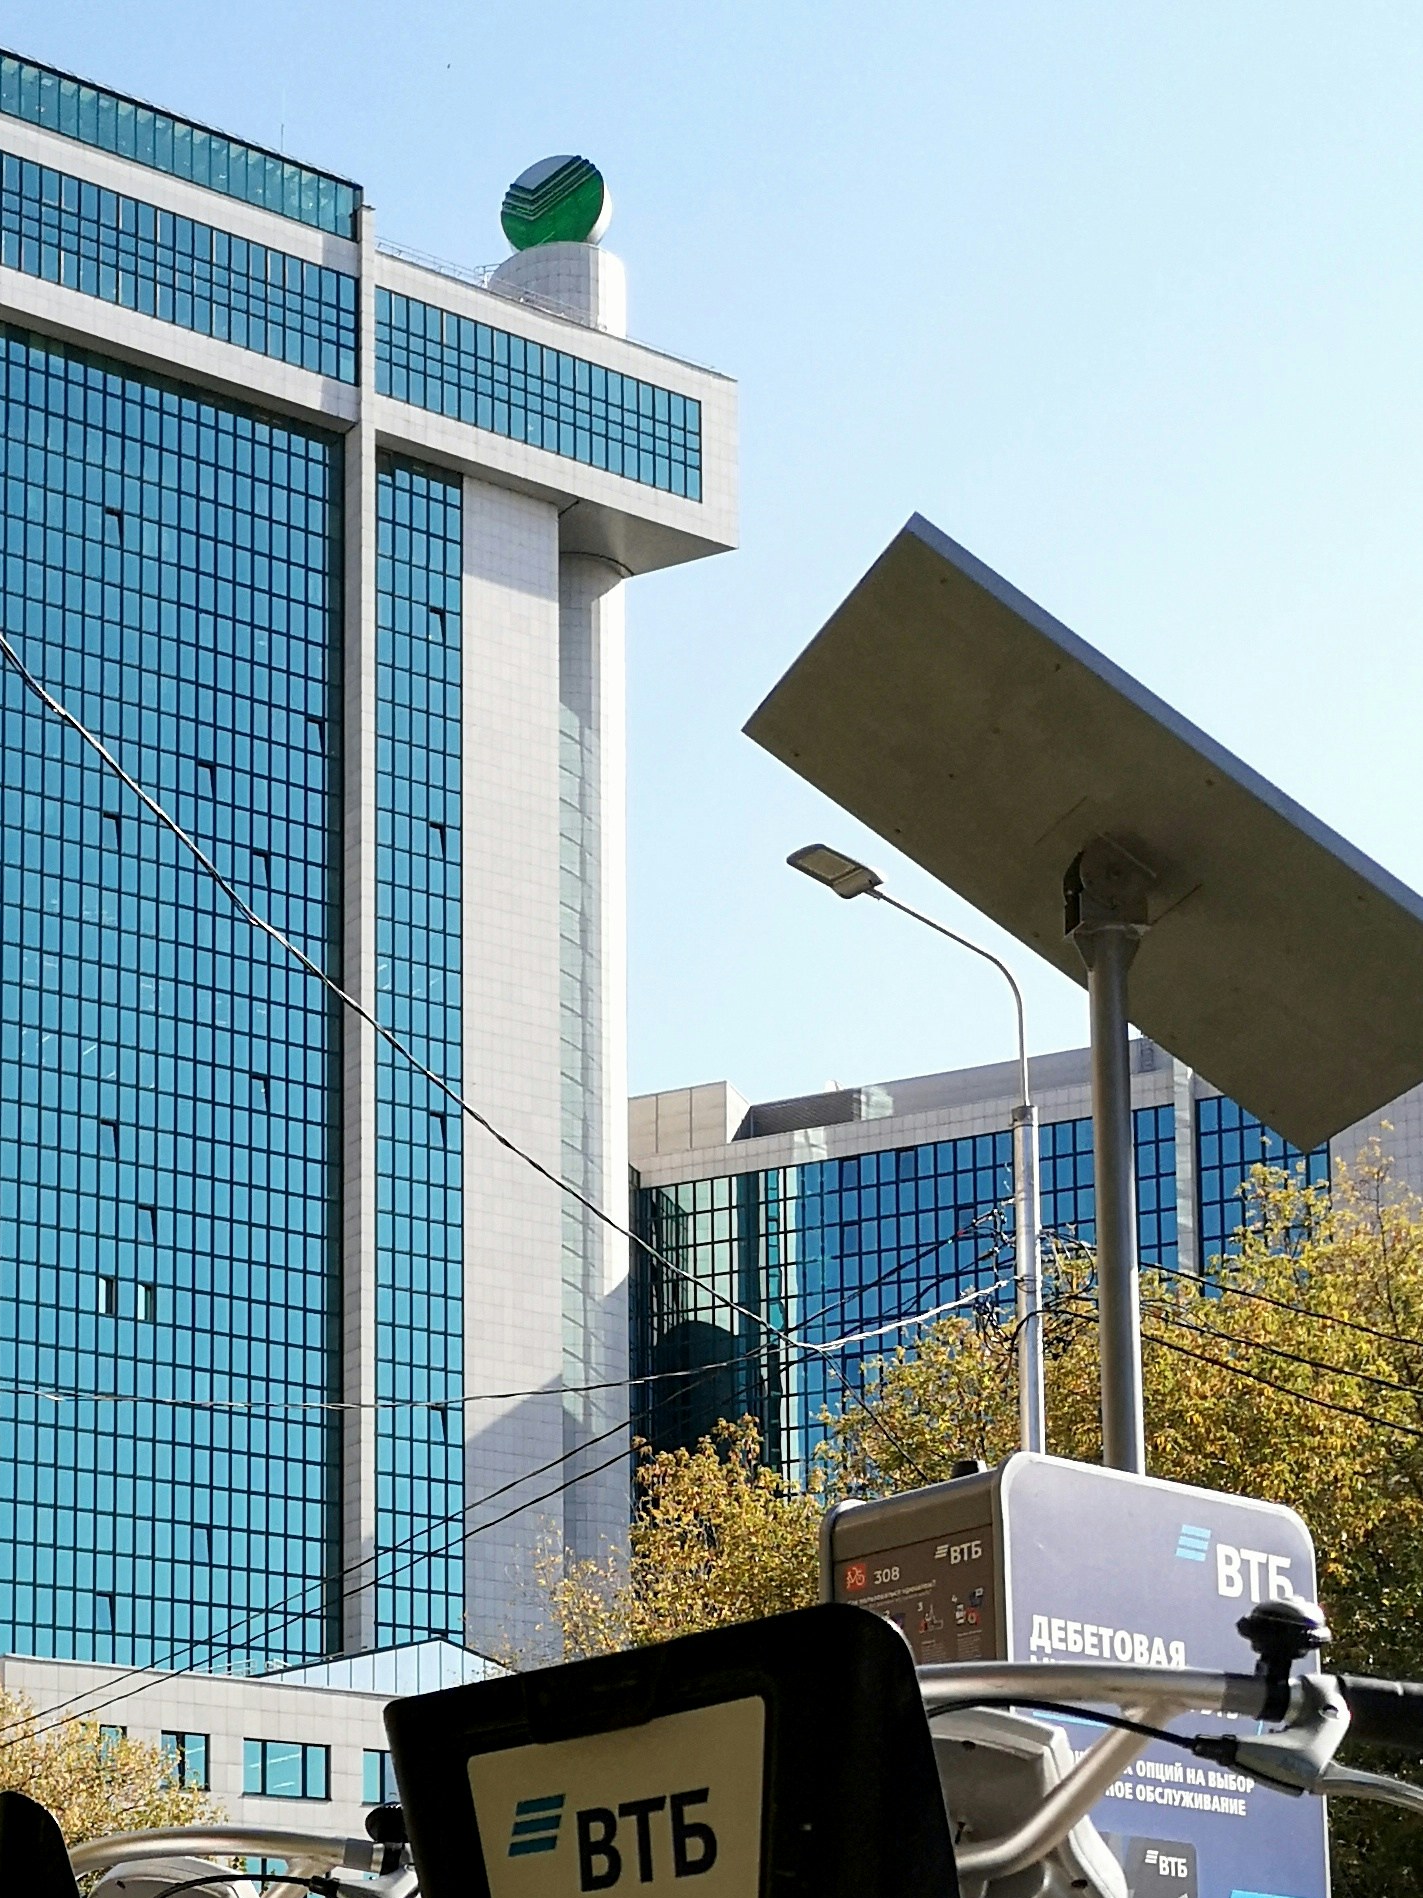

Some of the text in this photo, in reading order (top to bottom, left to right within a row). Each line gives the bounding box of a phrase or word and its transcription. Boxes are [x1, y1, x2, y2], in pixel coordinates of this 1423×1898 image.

[950, 1540, 982, 1565] ВТБ
[873, 1566, 900, 1585] 308
[1216, 1543, 1294, 1603] ВТБ
[917, 1602, 924, 1612] 3
[1029, 1614, 1186, 1670] ДЕБЕТОВАЯ
[1135, 1760, 1255, 1794] ОПЦИЙ НА ВЫБОР
[1135, 1784, 1247, 1817] ОБСЛУЖИВАНИЕ
[577, 1787, 718, 1892] ВТБ
[1159, 1855, 1188, 1878] ВТБ
